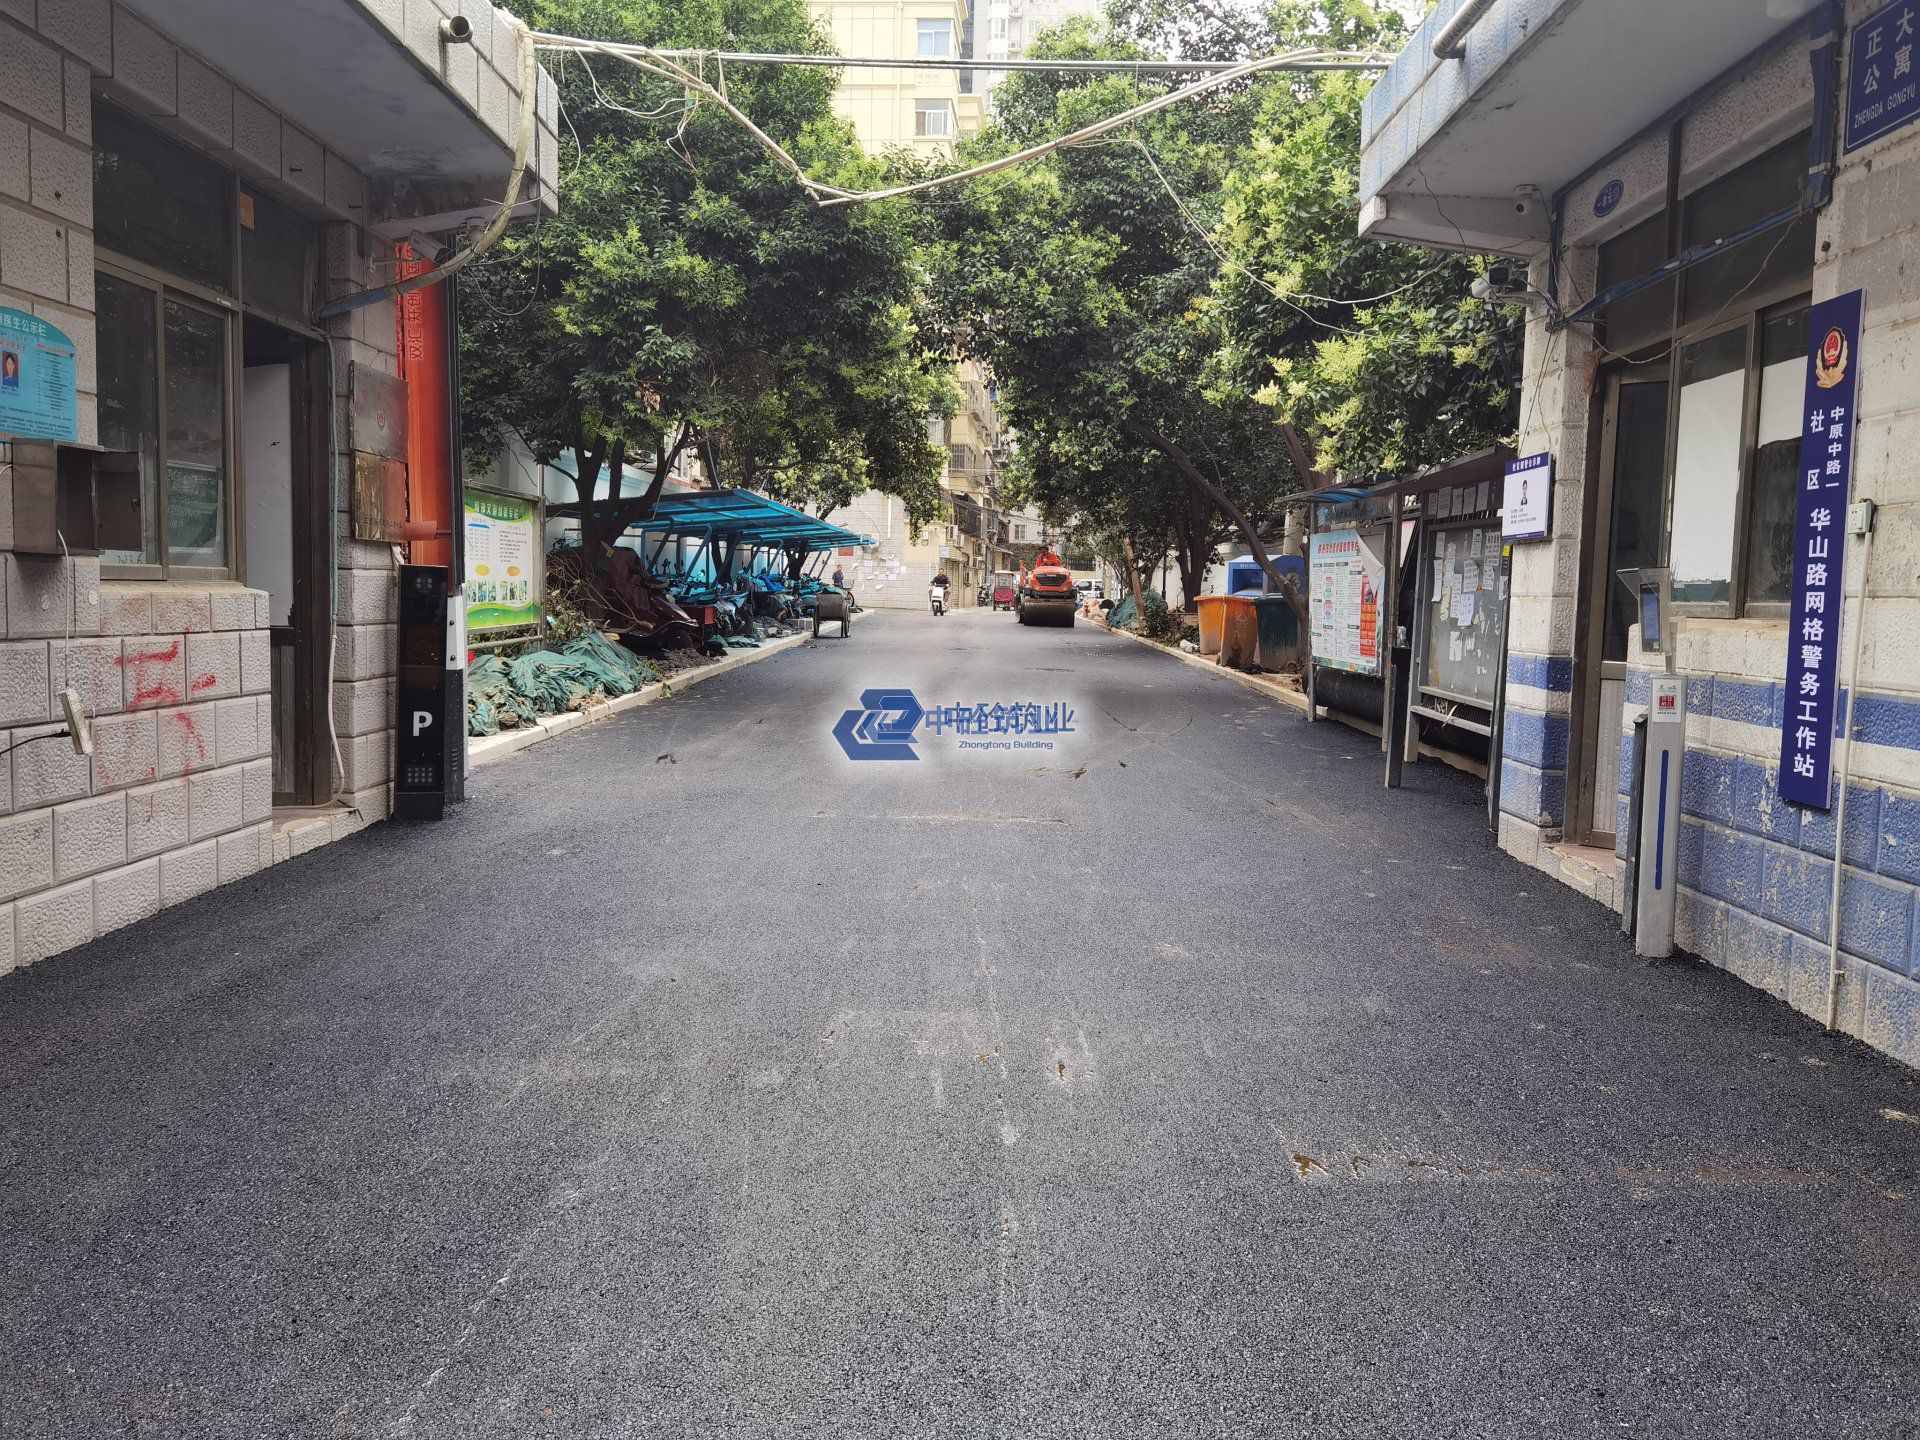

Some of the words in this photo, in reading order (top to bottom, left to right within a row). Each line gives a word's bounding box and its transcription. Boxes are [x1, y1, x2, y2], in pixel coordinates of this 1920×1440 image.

[1854, 101, 1884, 128] ZHENGDA
[1887, 82, 1916, 110] GONGYU
[1807, 408, 1825, 490] 社区
[1793, 507, 1831, 778] 华山路网格警务工作站
[412, 710, 433, 737] P
